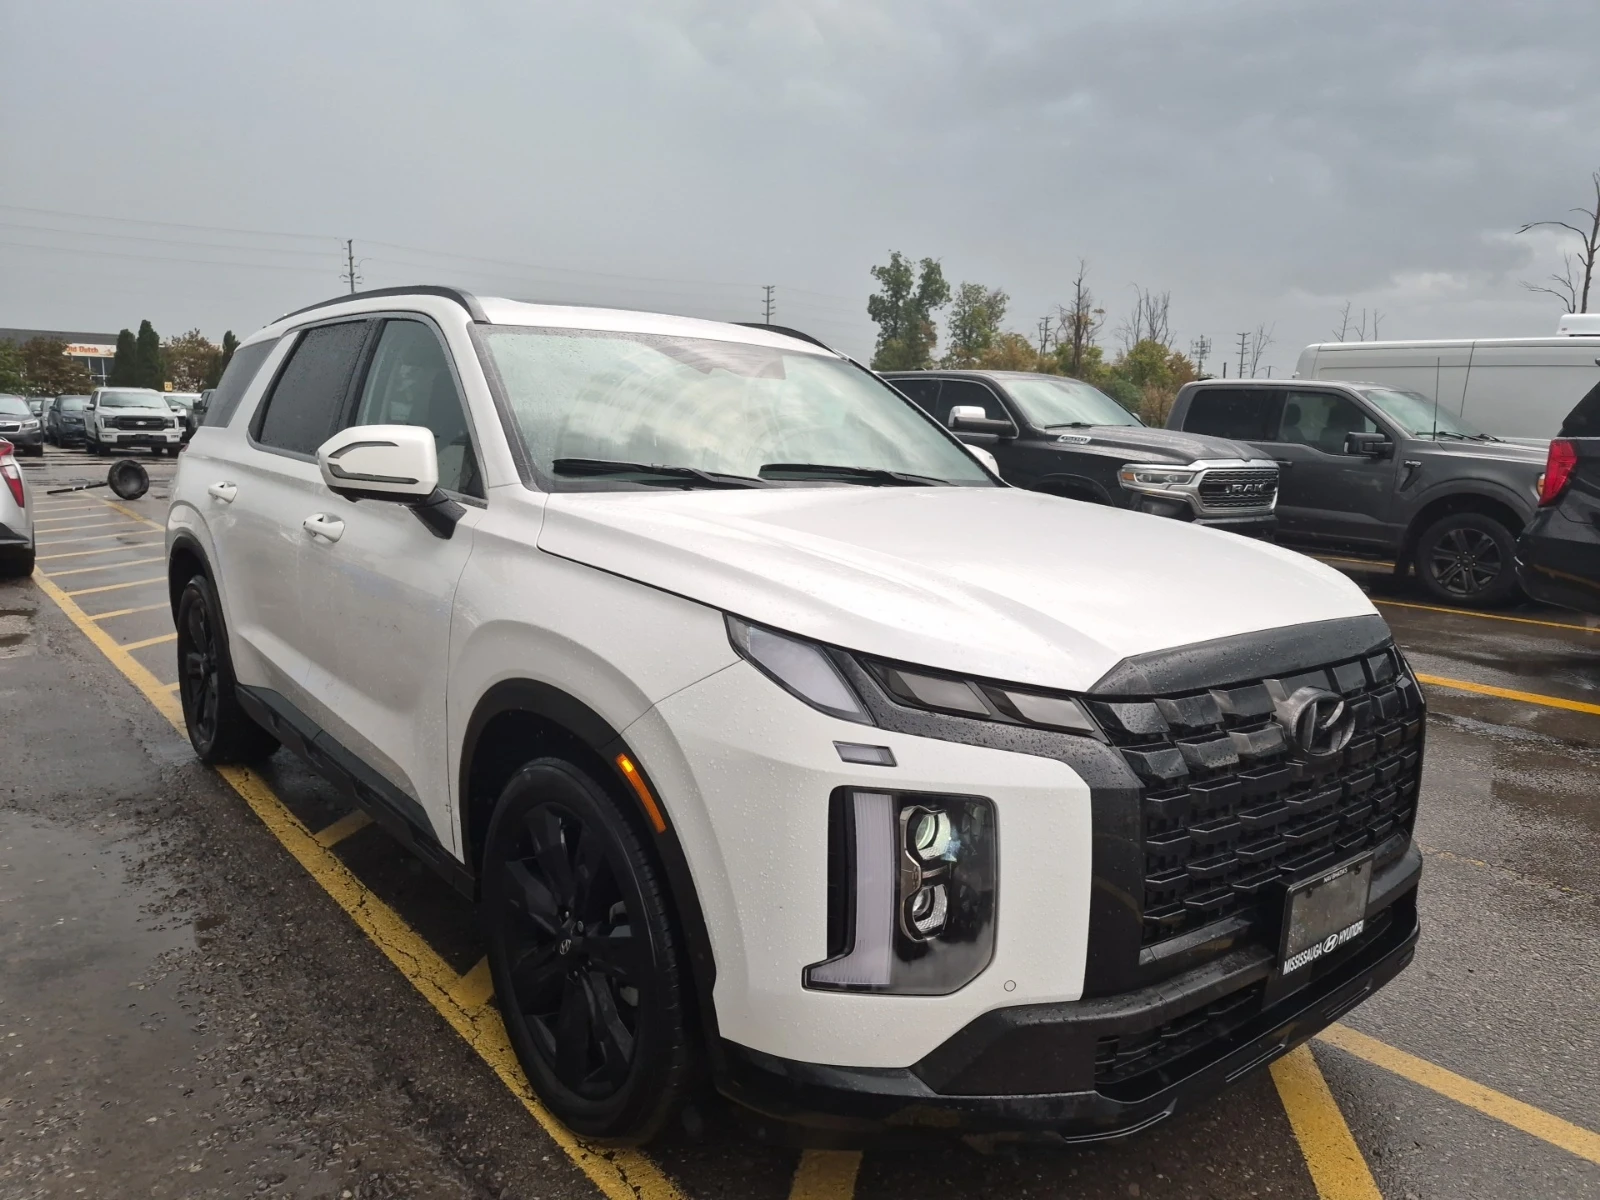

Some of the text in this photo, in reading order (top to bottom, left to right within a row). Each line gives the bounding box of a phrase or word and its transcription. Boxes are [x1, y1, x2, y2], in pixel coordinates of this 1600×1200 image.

[79, 345, 99, 353] Dutch
[1231, 483, 1265, 493] RAM
[1282, 919, 1365, 976] MISSISSAUGA HYUNDAI
